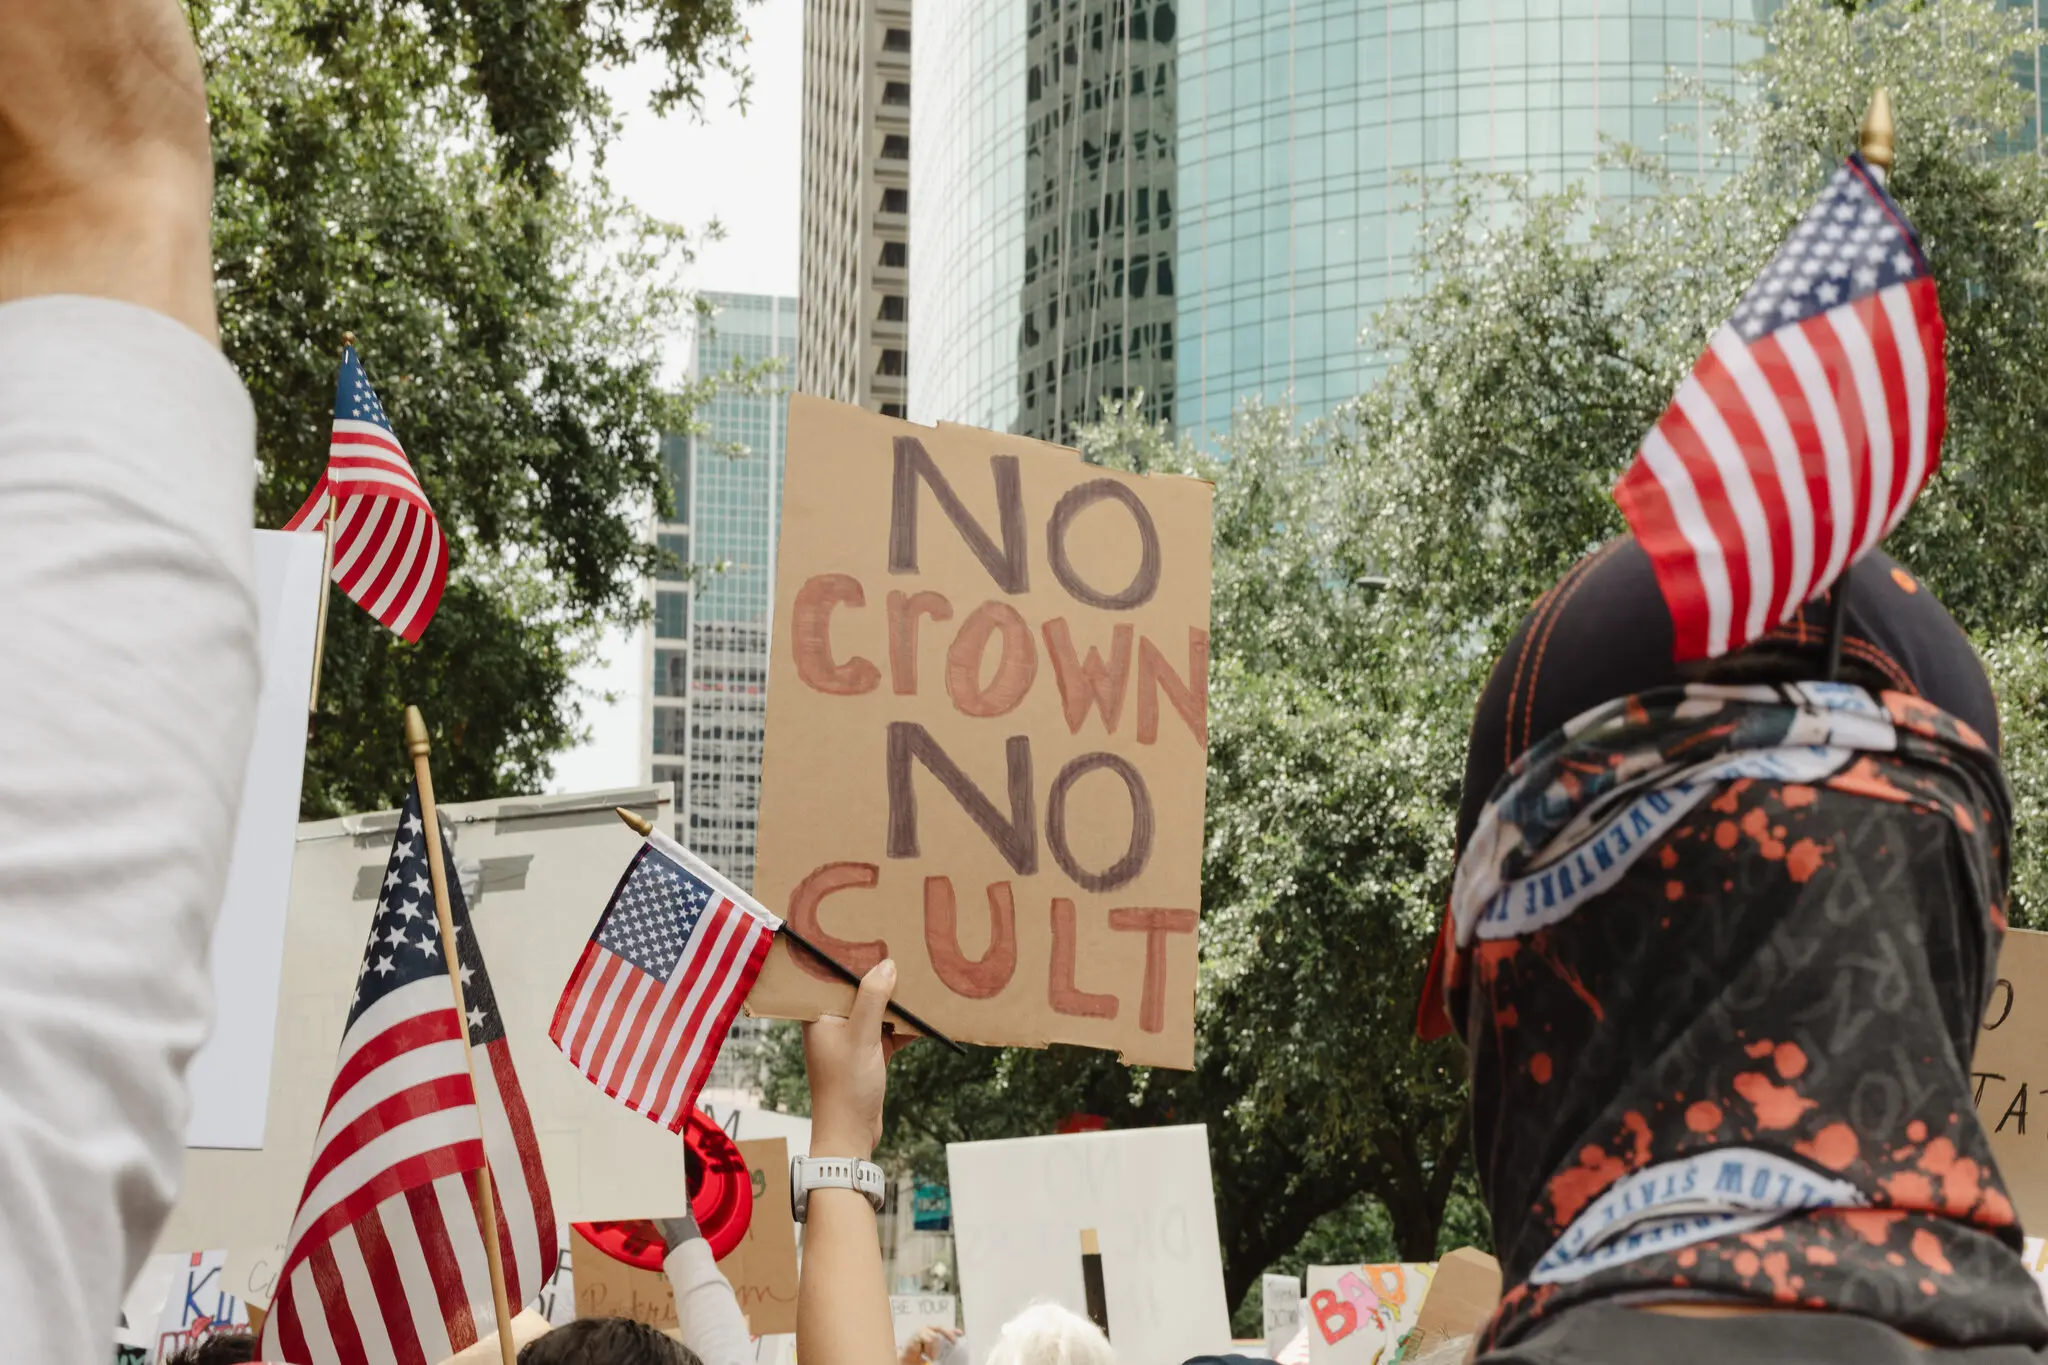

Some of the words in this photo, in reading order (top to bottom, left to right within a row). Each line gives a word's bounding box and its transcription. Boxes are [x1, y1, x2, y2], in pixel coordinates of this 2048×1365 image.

[888, 435, 1161, 610] NO
[886, 721, 1154, 893] NO
[785, 861, 1199, 1033] CULT
[1310, 1263, 1407, 1345] BAD
